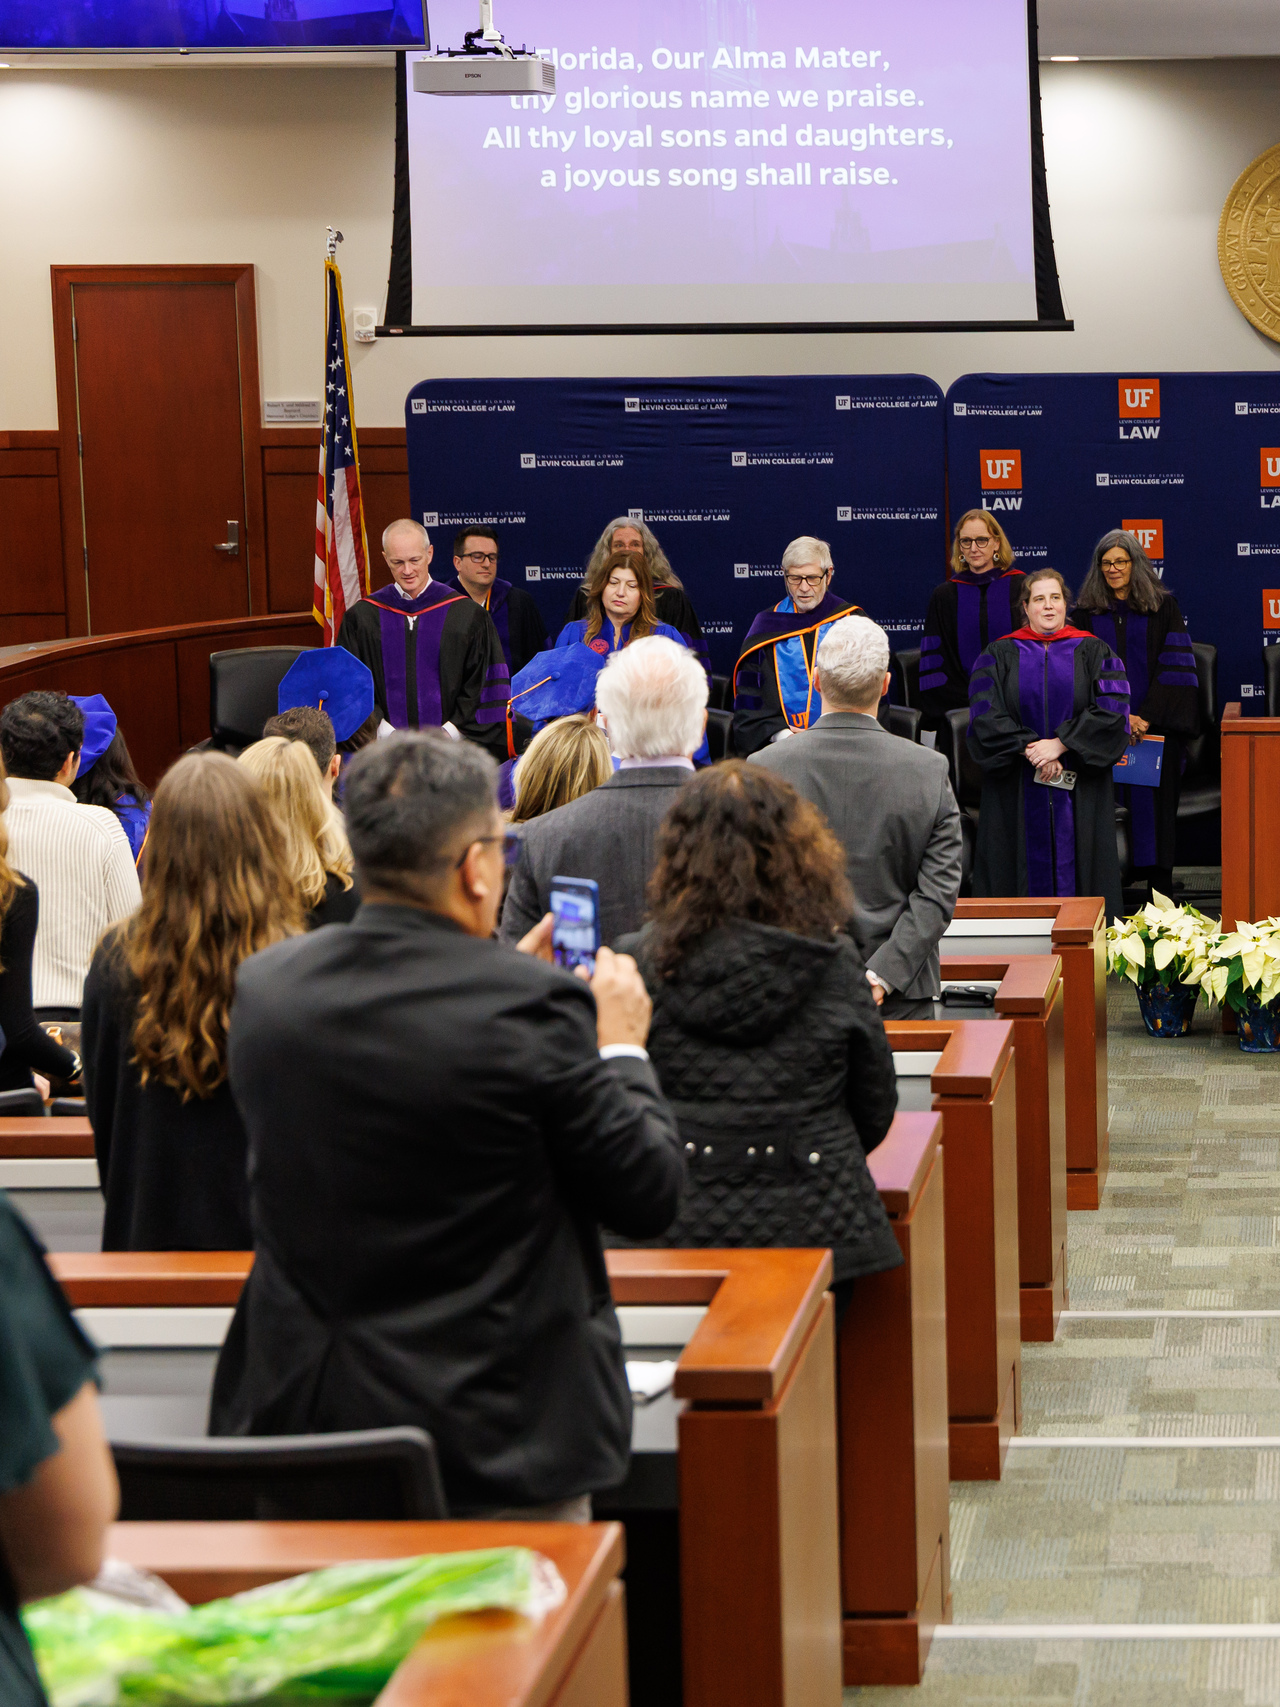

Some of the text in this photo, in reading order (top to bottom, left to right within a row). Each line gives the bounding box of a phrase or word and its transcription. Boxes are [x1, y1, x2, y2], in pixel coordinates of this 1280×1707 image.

[651, 48, 704, 70] Our
[712, 46, 786, 69] Alma
[795, 47, 889, 72] Mater,
[509, 83, 924, 114] thy glorious name we praise.
[483, 123, 953, 152] All thy loyal sons and daughters,
[541, 161, 898, 192] a joyous song shall raise.
[1230, 179, 1260, 221] SEAL
[1225, 229, 1247, 290] GREAT
[1259, 308, 1280, 329] IN
[1125, 389, 1153, 407] UF
[1119, 426, 1160, 439] LAW
[986, 459, 1015, 479] UF
[982, 498, 1022, 510] LAW
